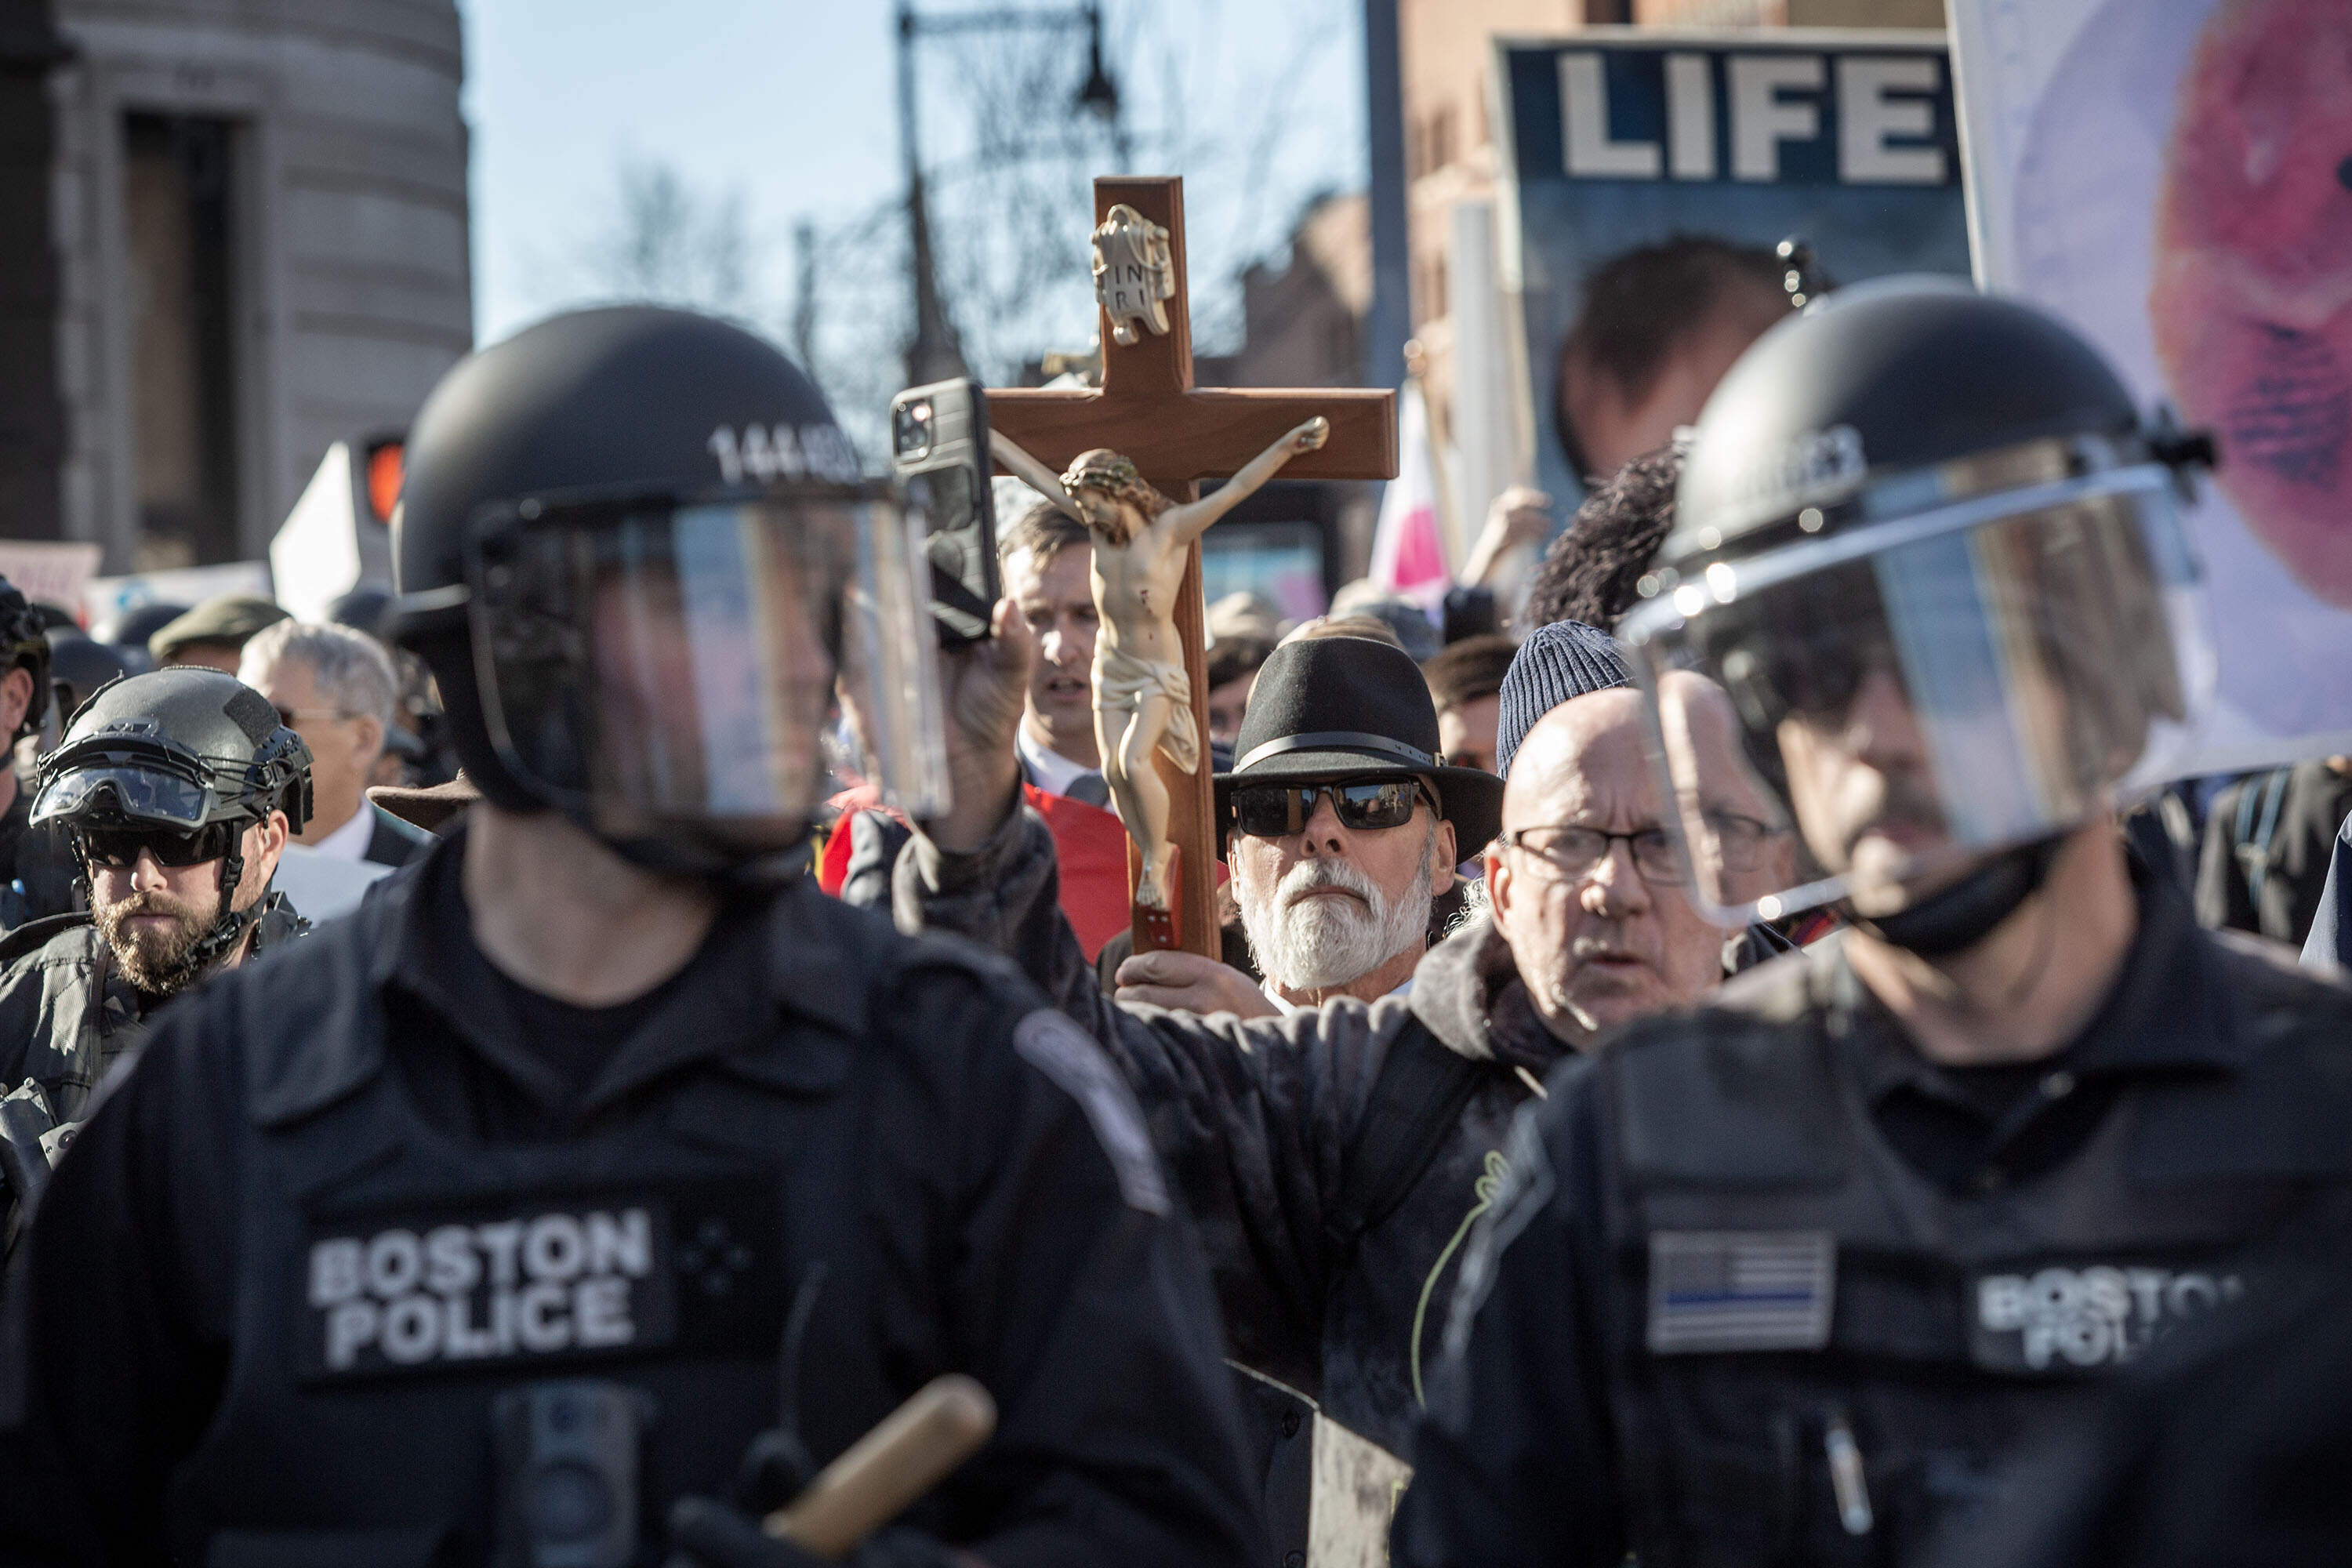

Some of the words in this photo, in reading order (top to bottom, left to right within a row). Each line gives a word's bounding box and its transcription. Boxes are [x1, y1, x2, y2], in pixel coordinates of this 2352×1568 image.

[1558, 52, 1950, 184] LIFE
[1115, 265, 1143, 285] IN
[1115, 289, 1145, 310] RI
[310, 1208, 651, 1308] BOSTON
[326, 1277, 634, 1370] POLICE
[1978, 1265, 2242, 1332] BOSTO
